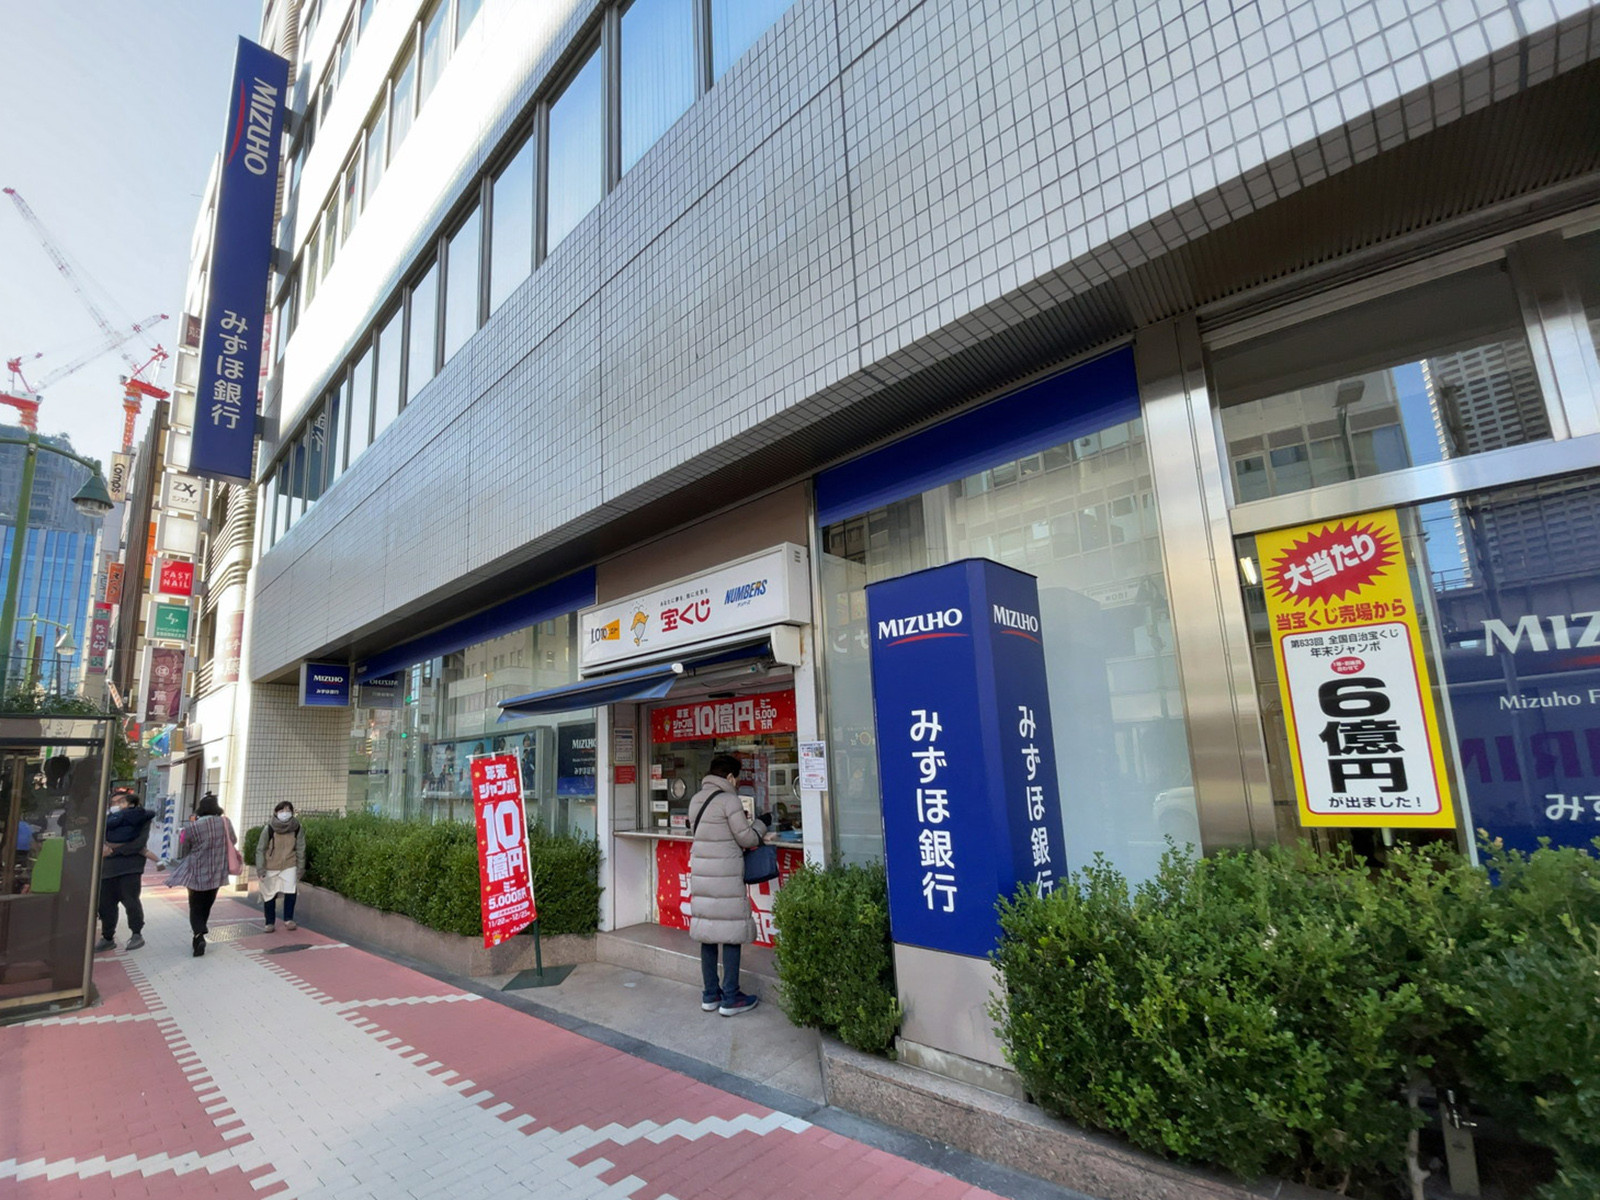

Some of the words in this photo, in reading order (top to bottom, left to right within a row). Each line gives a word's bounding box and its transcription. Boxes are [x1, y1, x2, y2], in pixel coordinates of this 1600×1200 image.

[244, 77, 278, 176] MIZUHO
[211, 309, 249, 430] みずほ銀行
[163, 570, 191, 580] FAST
[1283, 533, 1377, 595] 大当たり
[163, 579, 190, 588] NAIL
[724, 579, 768, 606] NUMBERS
[660, 598, 711, 633] 宝くじ
[878, 607, 963, 641] MIZUHO
[993, 604, 1039, 634] MIZUHO
[1276, 599, 1408, 632] 当宝くじ売場から
[1310, 641, 1382, 658] 年末ジャンボ
[1329, 629, 1399, 645] 全国自治宝くじ
[313, 675, 343, 683] MIZUHO
[1500, 690, 1581, 711] Mizuho
[694, 699, 756, 737] 10億円
[479, 778, 517, 800] ジャンボ
[1018, 704, 1054, 901] みずほ銀行
[482, 799, 522, 855] 10
[909, 708, 958, 914] みずほ銀行
[486, 847, 525, 883] 億円
